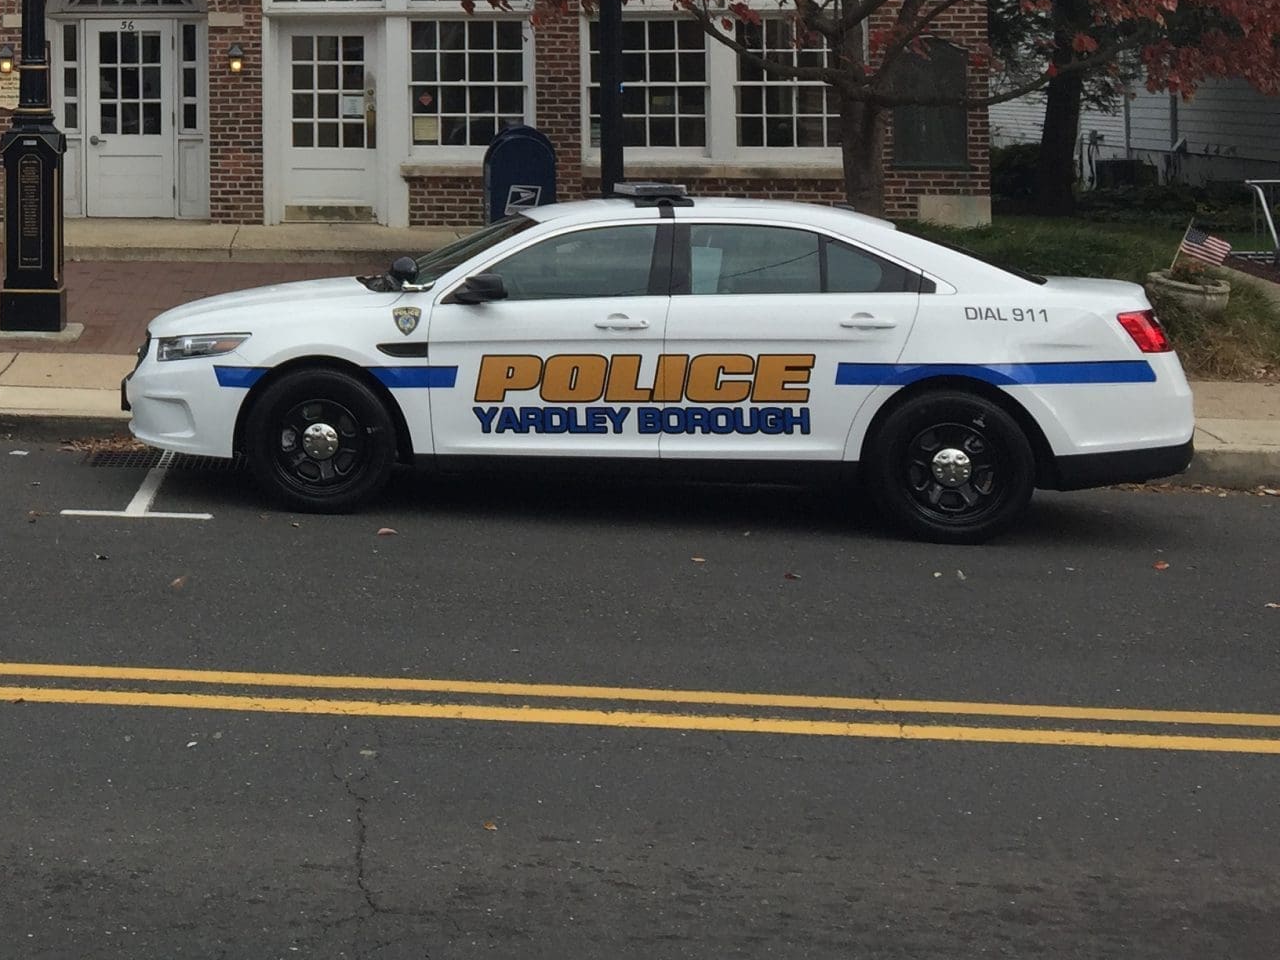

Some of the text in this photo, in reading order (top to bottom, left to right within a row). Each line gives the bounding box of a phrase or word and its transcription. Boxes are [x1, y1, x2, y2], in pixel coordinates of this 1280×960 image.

[120, 20, 135, 31] 56
[964, 306, 1049, 323] DIAL 911
[474, 353, 816, 404] POLICE
[472, 406, 812, 435] YARDLEY BOROUGH
